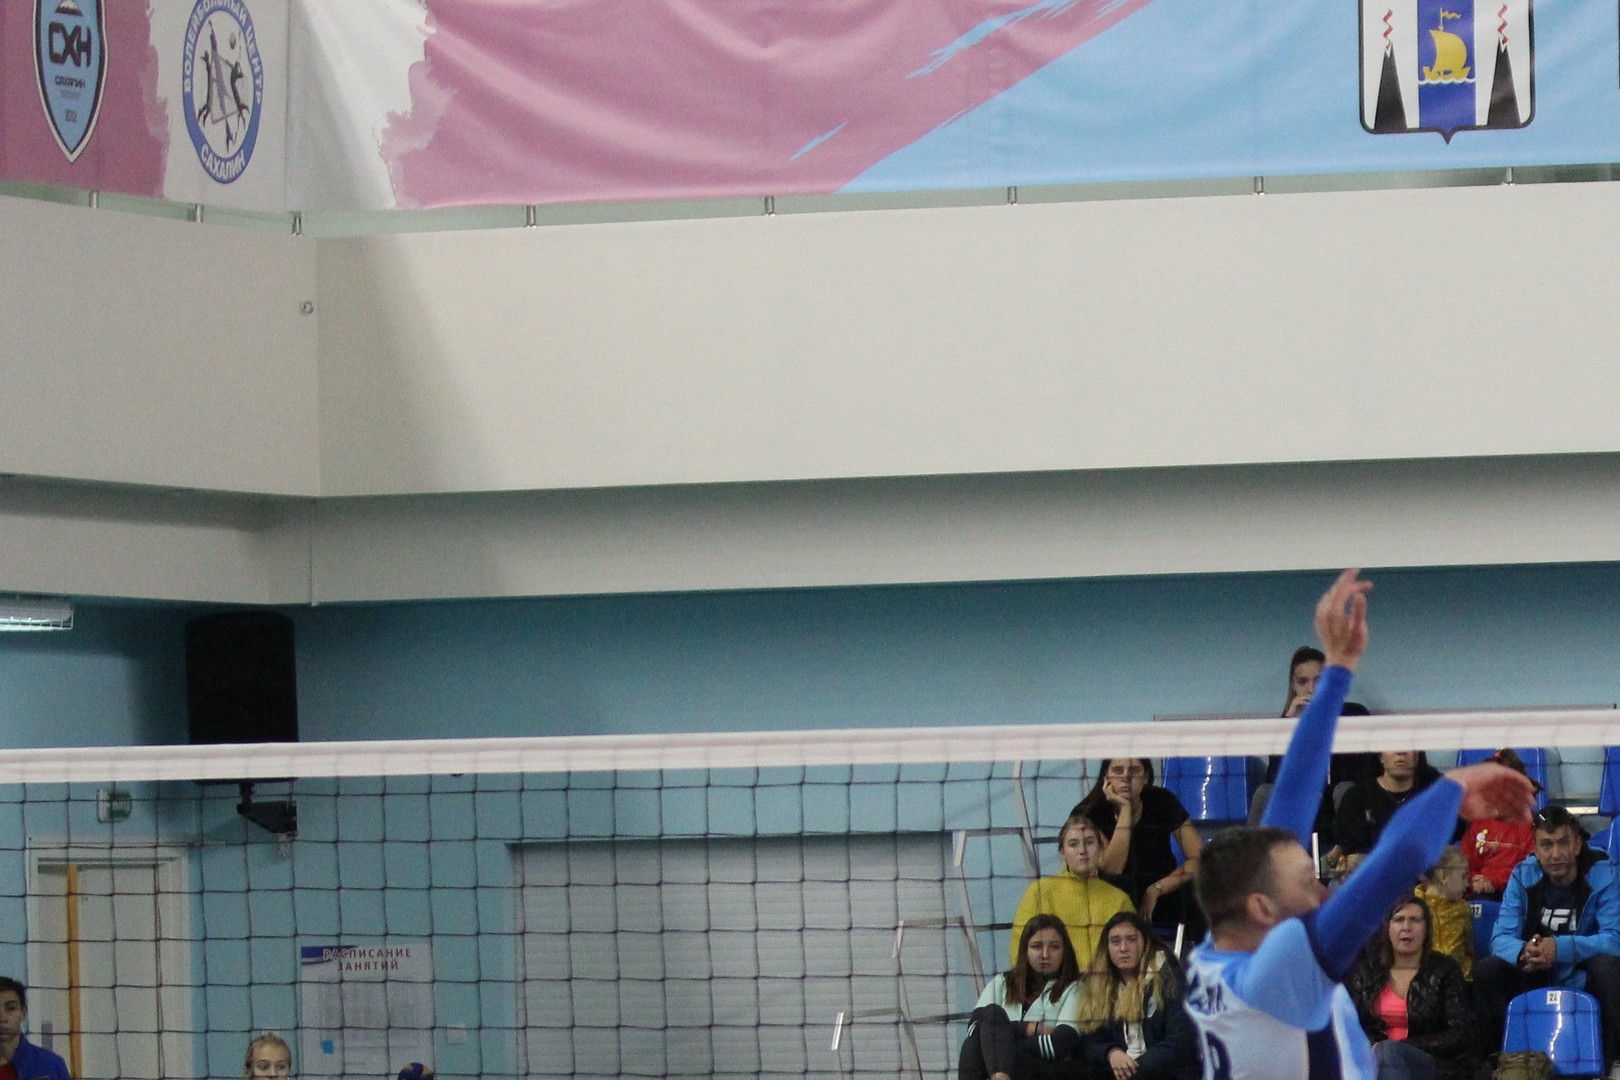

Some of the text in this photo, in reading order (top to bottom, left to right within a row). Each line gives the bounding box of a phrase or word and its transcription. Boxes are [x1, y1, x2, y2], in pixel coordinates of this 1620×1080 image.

[201, 144, 246, 180] САХАЛИН
[324, 947, 411, 959] РАСПИСАНИЕ
[338, 959, 399, 971] ЗАНЯТИЙ
